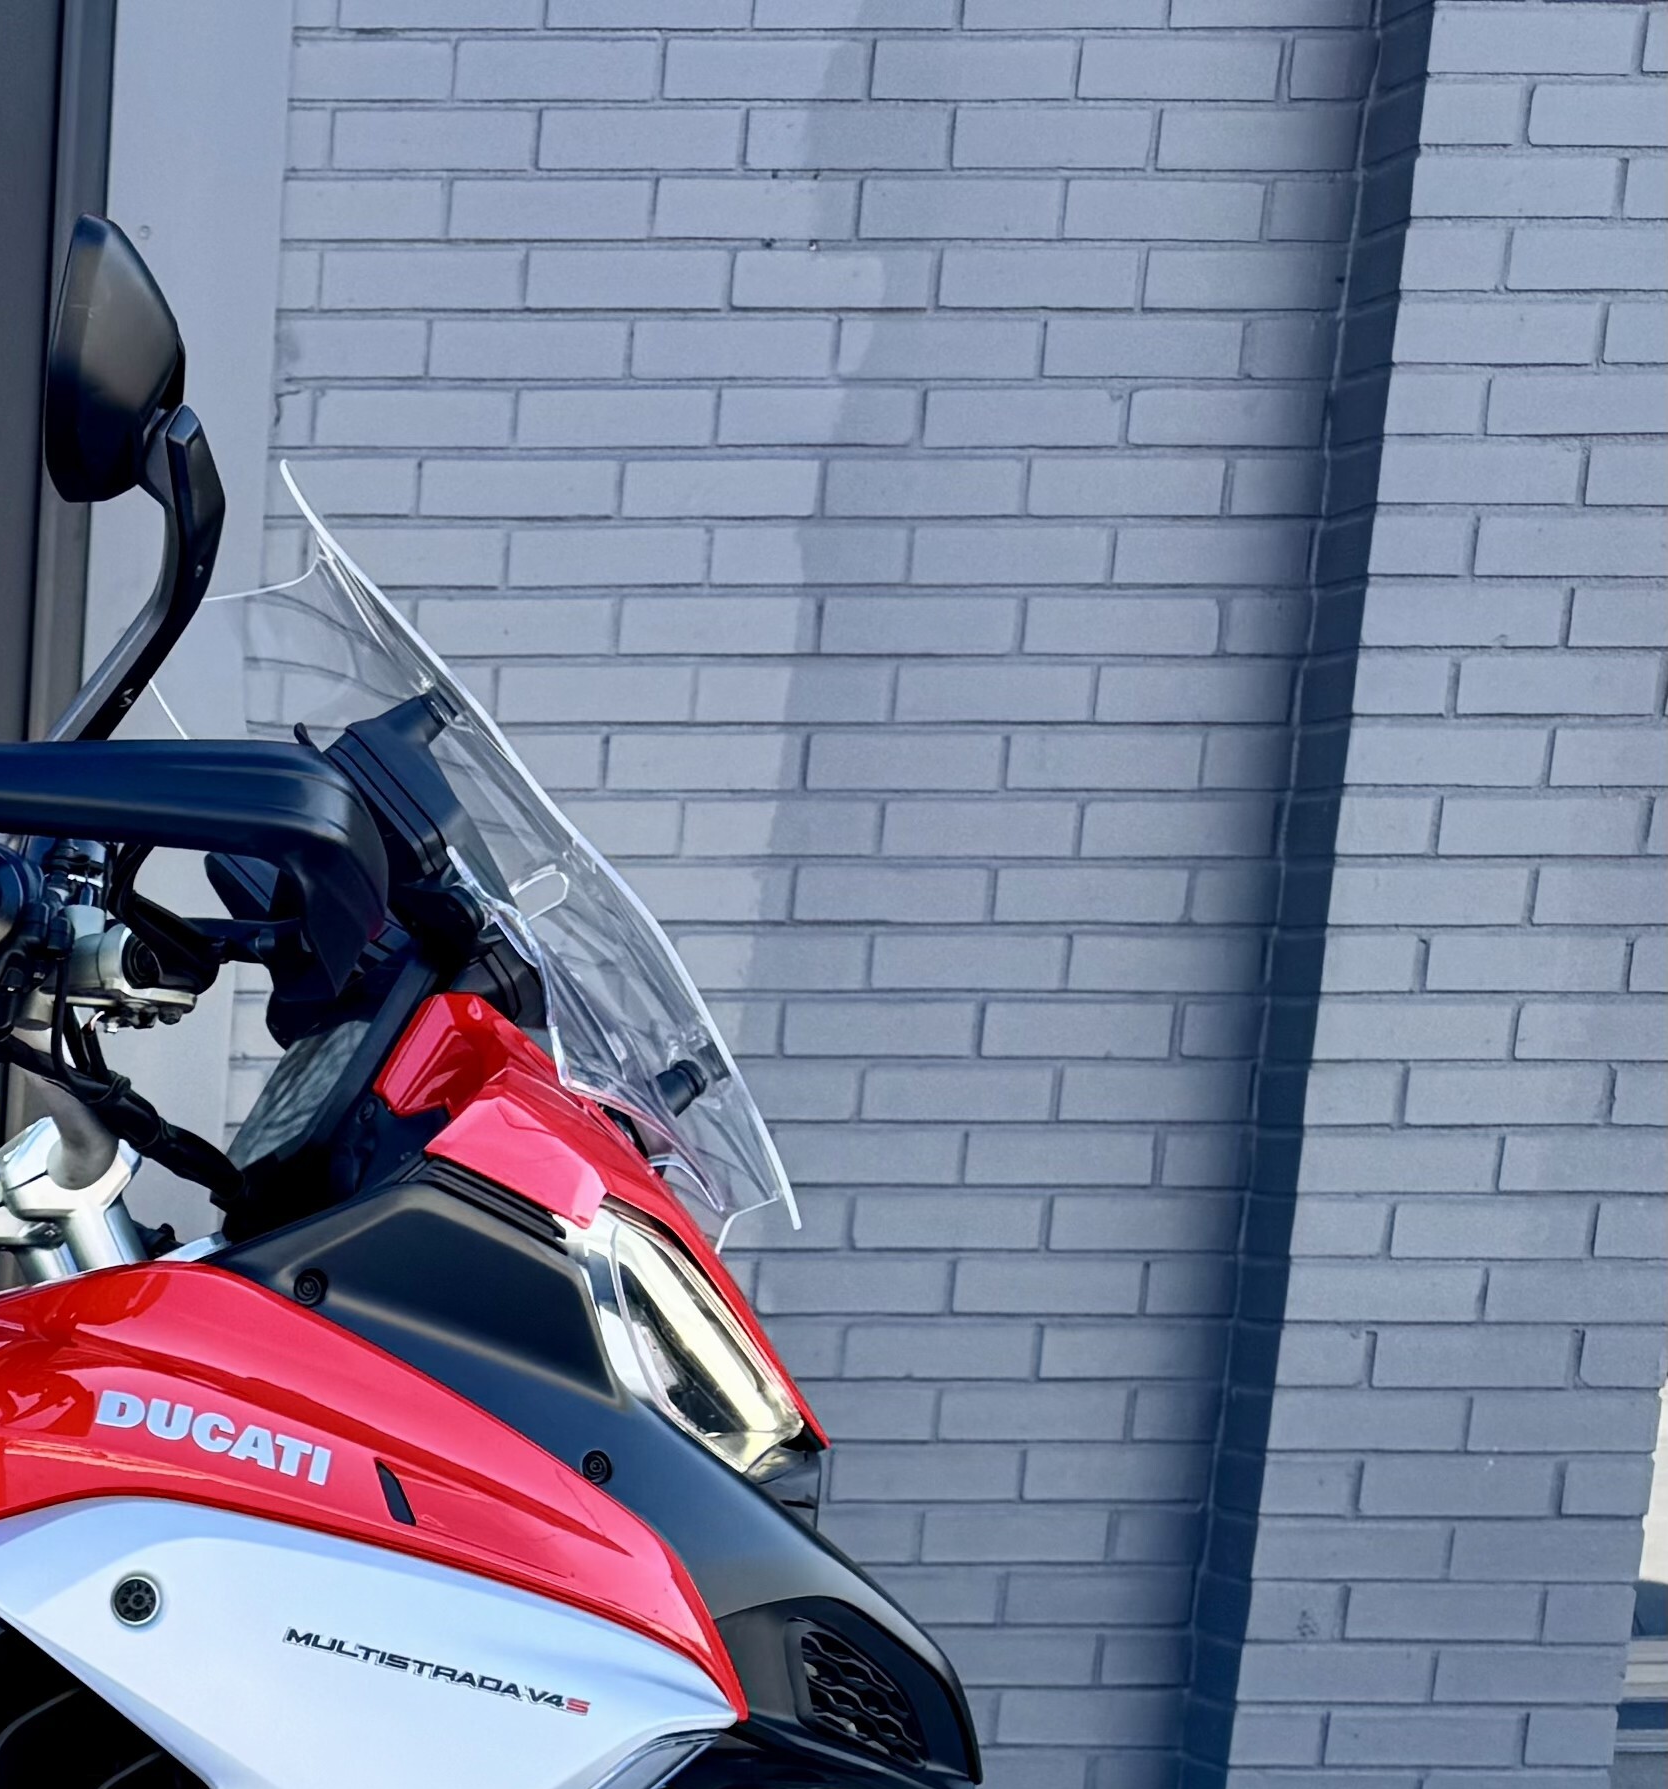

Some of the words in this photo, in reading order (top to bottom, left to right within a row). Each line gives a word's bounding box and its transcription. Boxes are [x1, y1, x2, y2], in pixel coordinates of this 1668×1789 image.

[94, 1389, 333, 1487] DUCATI
[283, 1626, 523, 1703] MULTISTRADA
[524, 1685, 592, 1717] V4S
